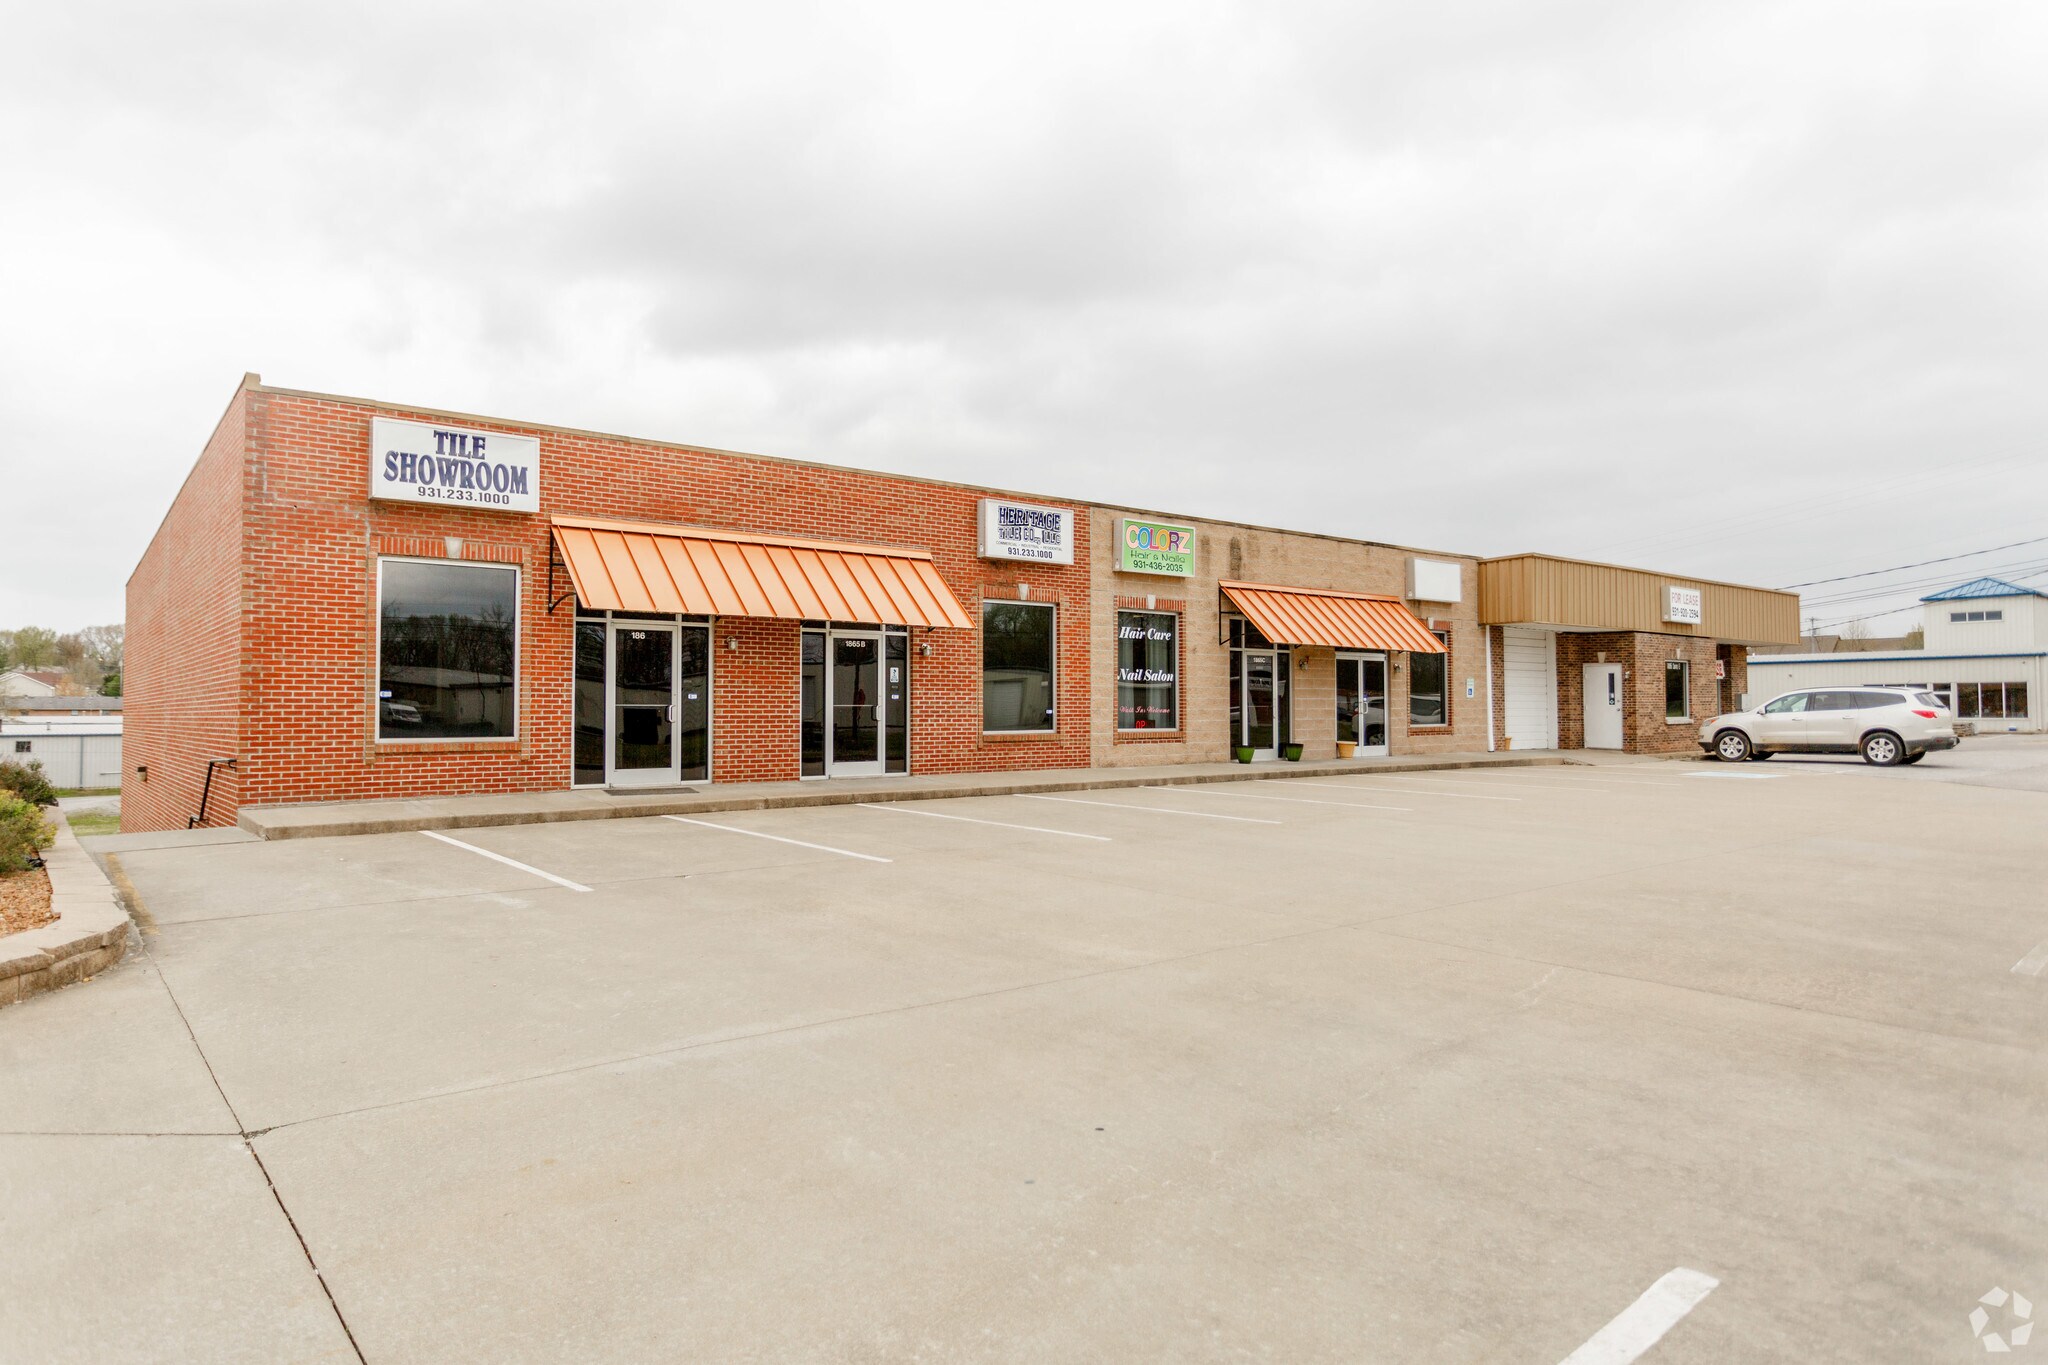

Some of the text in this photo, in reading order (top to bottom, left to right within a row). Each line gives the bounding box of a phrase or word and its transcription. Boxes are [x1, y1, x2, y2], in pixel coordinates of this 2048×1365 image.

[434, 430, 486, 460] TILE
[383, 450, 529, 495] SHOWROOM
[418, 486, 510, 505] 931.233.1000
[998, 506, 1061, 532] HERITAGE
[998, 527, 1022, 541] TILE
[1042, 530, 1061, 545] LLC
[1126, 525, 1191, 554] COLORZ
[1007, 547, 1053, 559] 931.233.1000
[1130, 550, 1151, 559] Hair
[1161, 553, 1186, 563] Nails
[1133, 560, 1184, 572] 931-436-2035
[1672, 592, 1699, 606] FOR LEASE
[1119, 626, 1172, 641] Hair Care
[1117, 668, 1174, 682] Nail Salon
